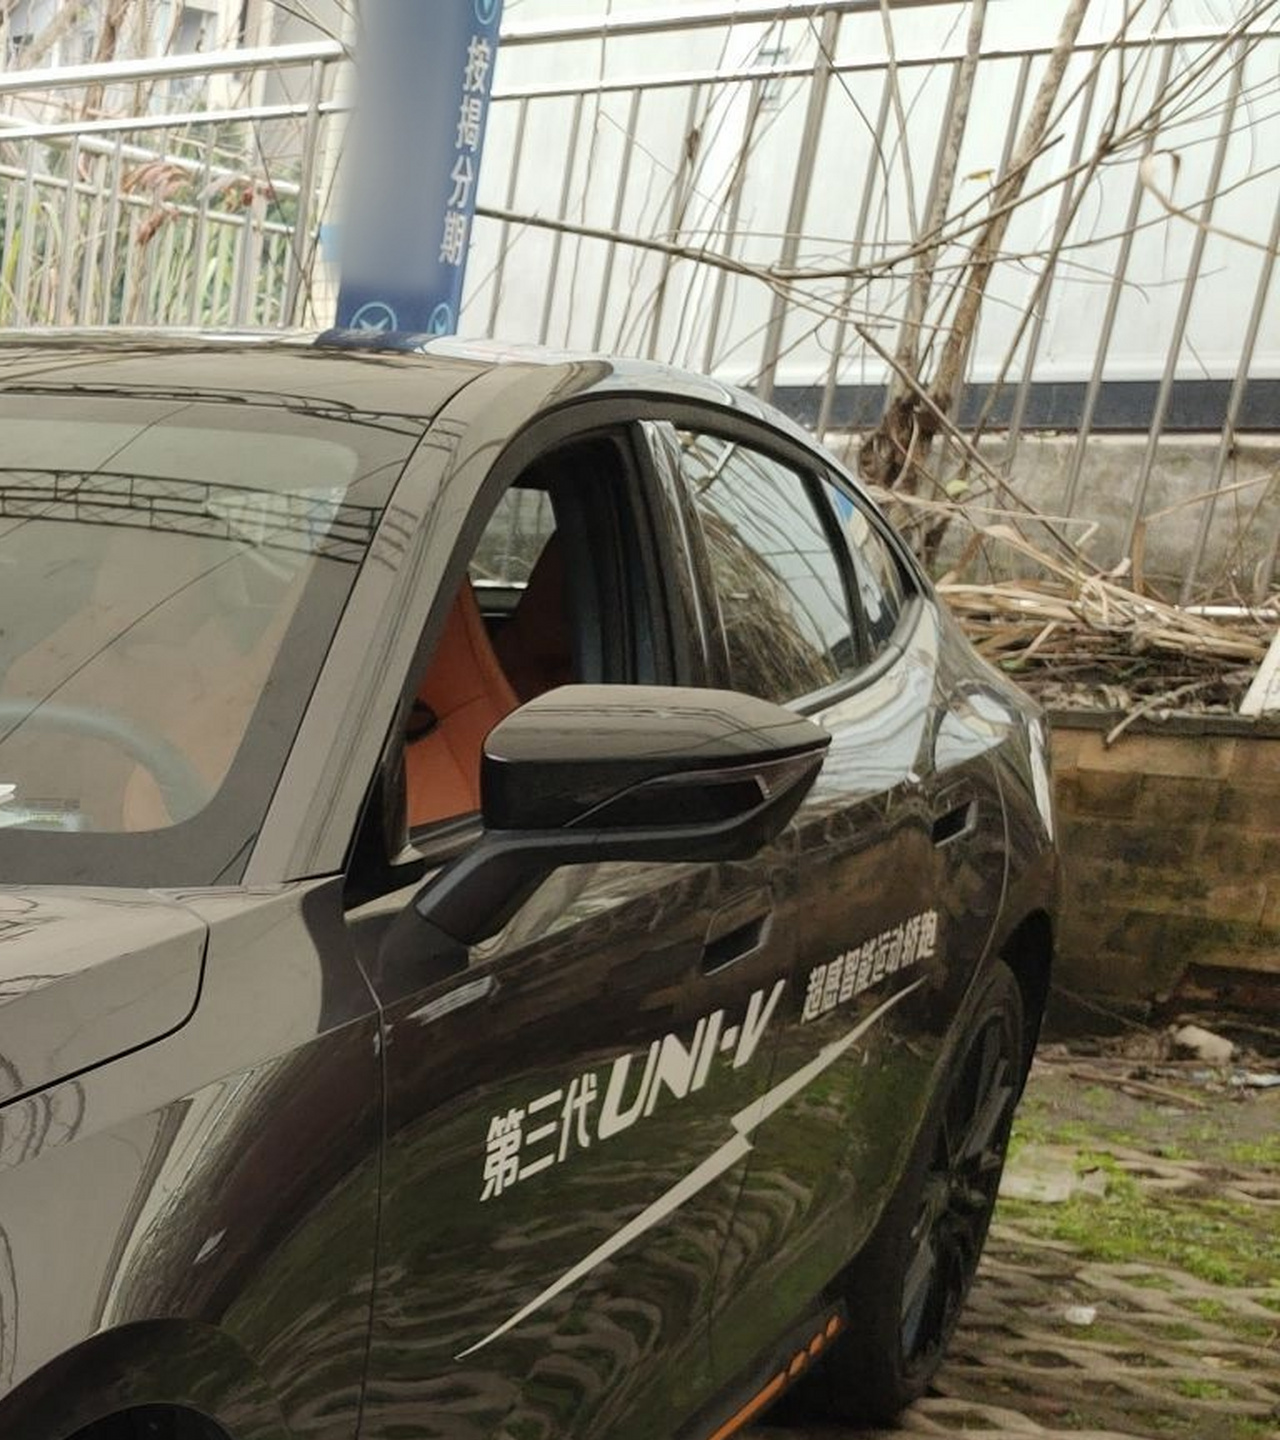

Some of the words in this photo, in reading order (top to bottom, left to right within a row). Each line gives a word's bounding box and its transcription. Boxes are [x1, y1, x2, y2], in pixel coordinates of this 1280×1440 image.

[439, 35, 492, 266] 按揭分期
[800, 907, 938, 1026] 超感智能运动轿跑
[479, 1072, 598, 1203] 第三代
[597, 978, 787, 1141] UNI-V
